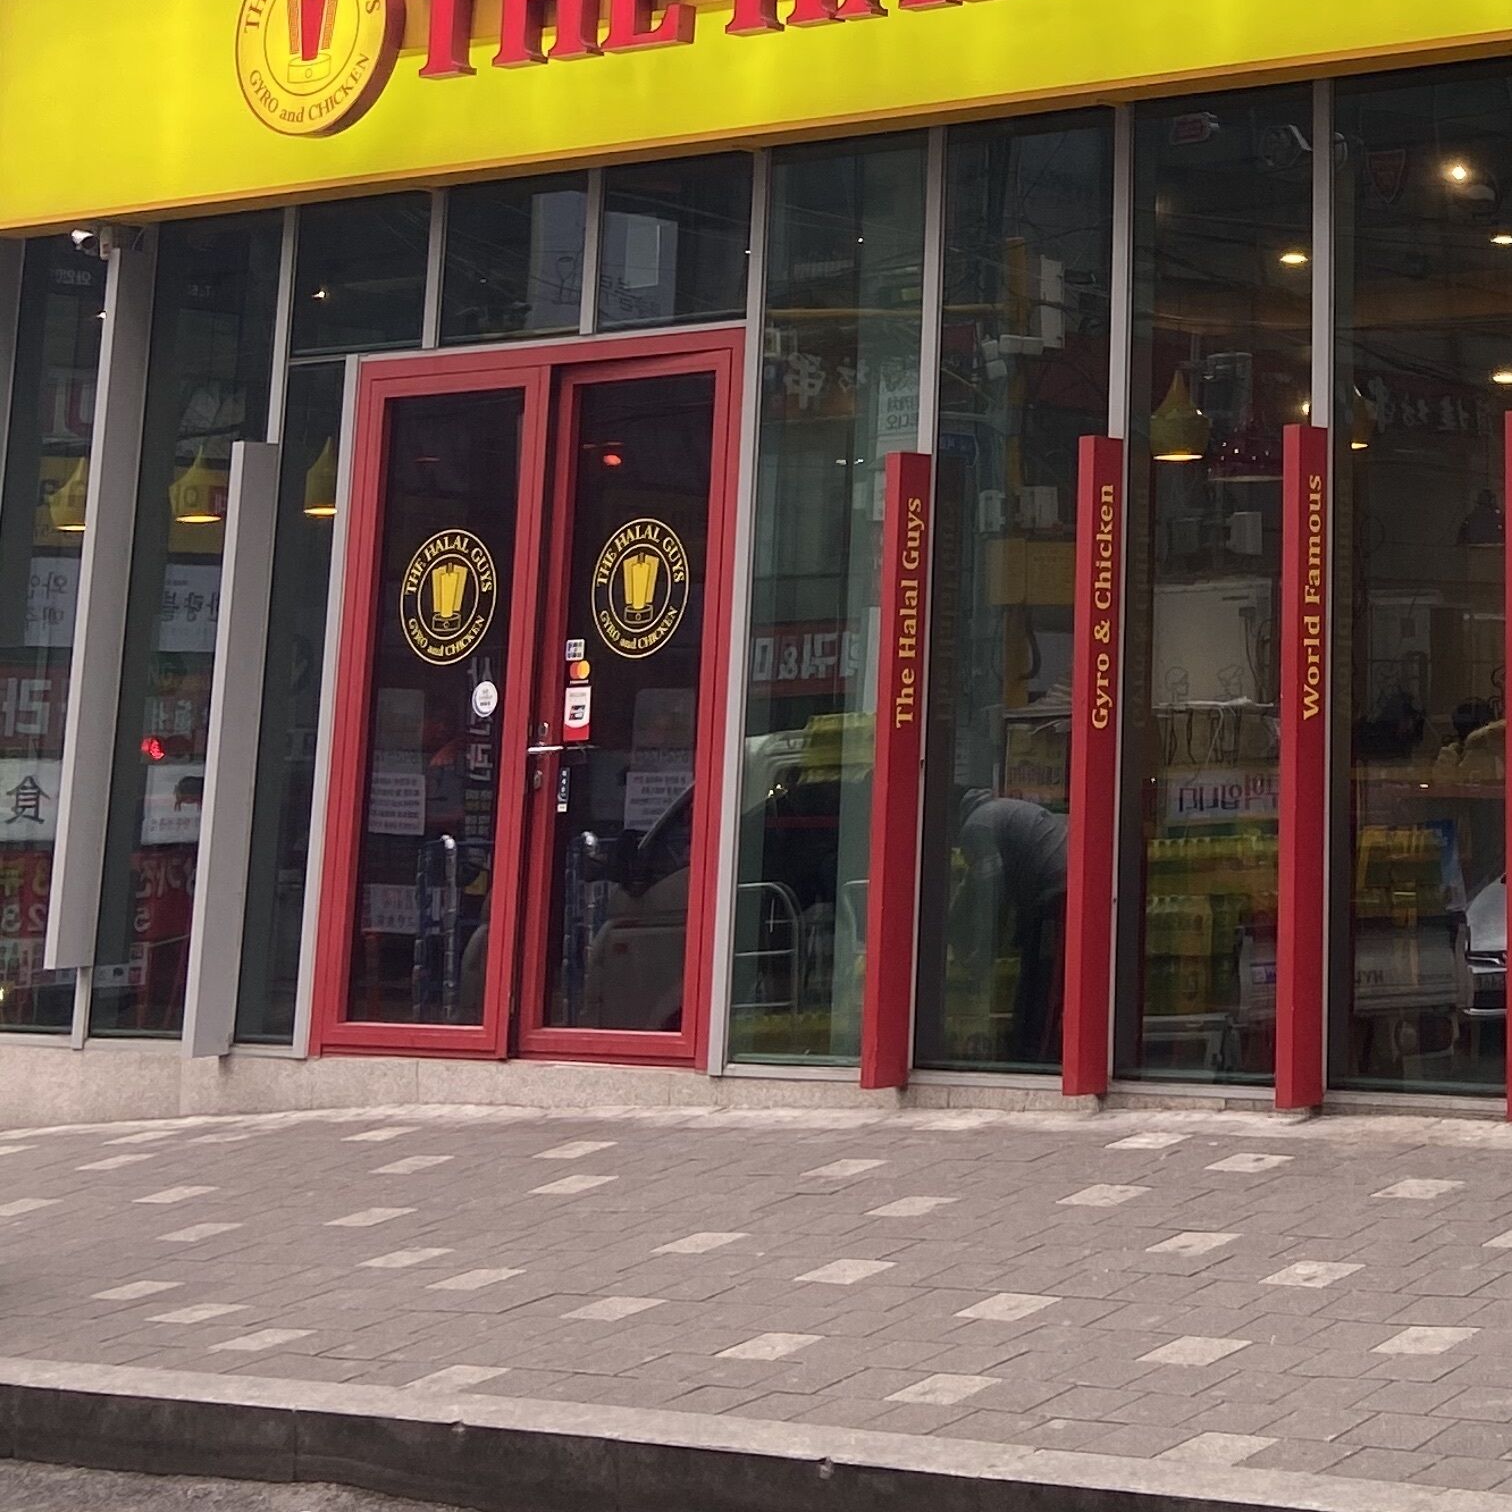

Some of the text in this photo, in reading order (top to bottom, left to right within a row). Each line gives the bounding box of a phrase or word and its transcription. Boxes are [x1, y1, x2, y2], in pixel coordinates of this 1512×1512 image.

[250, 53, 370, 123] GYRO and CHICKEN
[405, 535, 493, 595] THE HALAL GUYS
[597, 525, 685, 587] THE HALAL GUYS
[600, 610, 620, 641] GYRO
[896, 497, 922, 728] The Halal Guys
[1092, 485, 1115, 729] Gyro & Chicken
[1303, 475, 1322, 720] World Famous
[408, 618, 428, 648] GYRO
